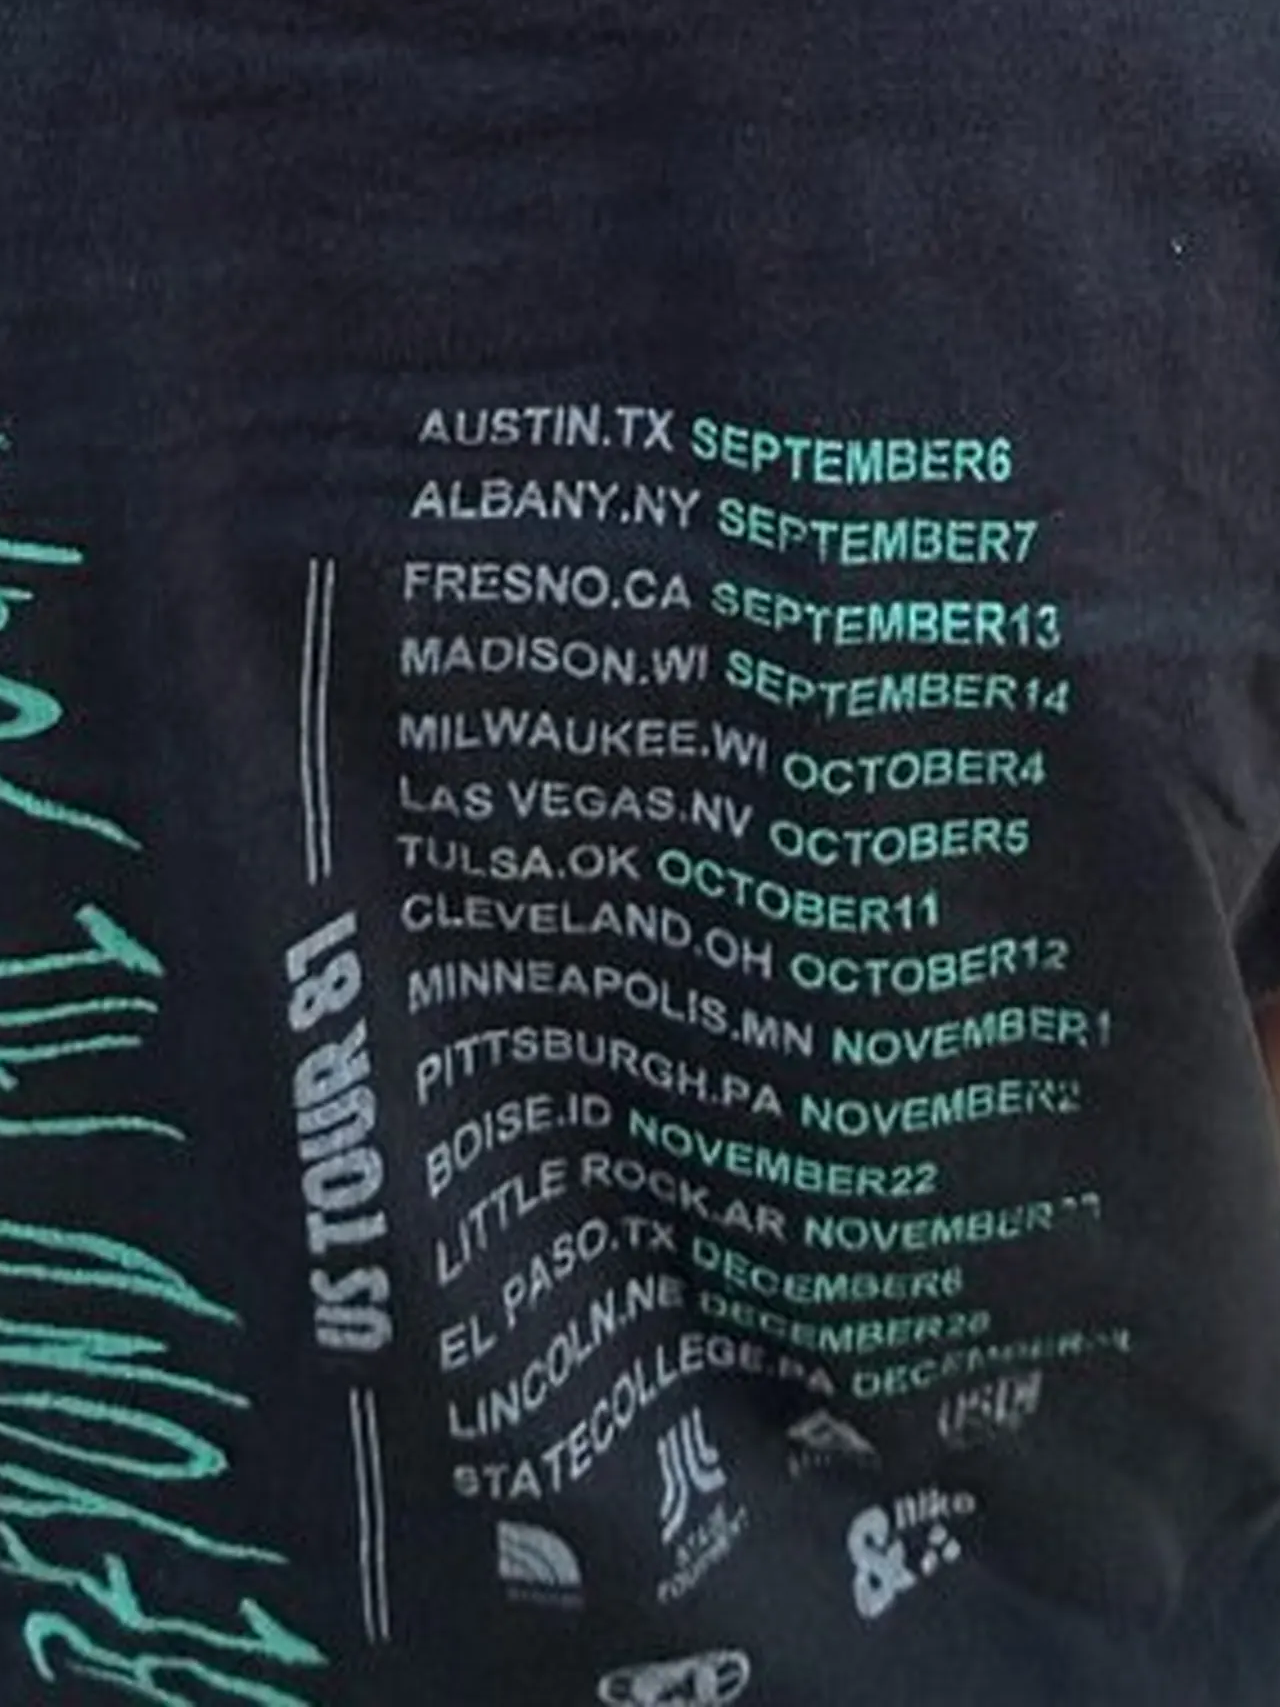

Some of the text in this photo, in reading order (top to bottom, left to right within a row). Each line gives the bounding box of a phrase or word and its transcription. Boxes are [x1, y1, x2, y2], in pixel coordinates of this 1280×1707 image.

[418, 403, 1012, 482] AUSTIN.TX SEPTEMBER6
[411, 480, 1038, 565] ALBANY.NY SEPTEMBER7
[404, 563, 1061, 647] FRESNO.CA SEPTEMBER13
[401, 638, 1070, 717] MADISON.WI SEPTEMBER14
[398, 712, 1046, 795] MILWAUKEE.WI OCTOBER4
[400, 776, 1029, 868] LAS VEGAS.NV OCTOBER5
[398, 836, 940, 933] TULSA.OK OCTOBER11
[401, 895, 1070, 998] CLEVELAND.OH OCTOBER12
[409, 959, 813, 1057] MINNEAPOLIS.MN
[416, 1027, 782, 1119] PITTSBURGH.PA
[285, 912, 392, 1351] US TOUR 81
[426, 1094, 939, 1198] BOISE.ID NOVEMBER22
[437, 1157, 567, 1285] LITTLE
[581, 1153, 788, 1242] ROCK.AR
[441, 1316, 495, 1372] EL
[502, 1217, 677, 1329] PASO.TX
[449, 1275, 684, 1440] LINCOLN.NE
